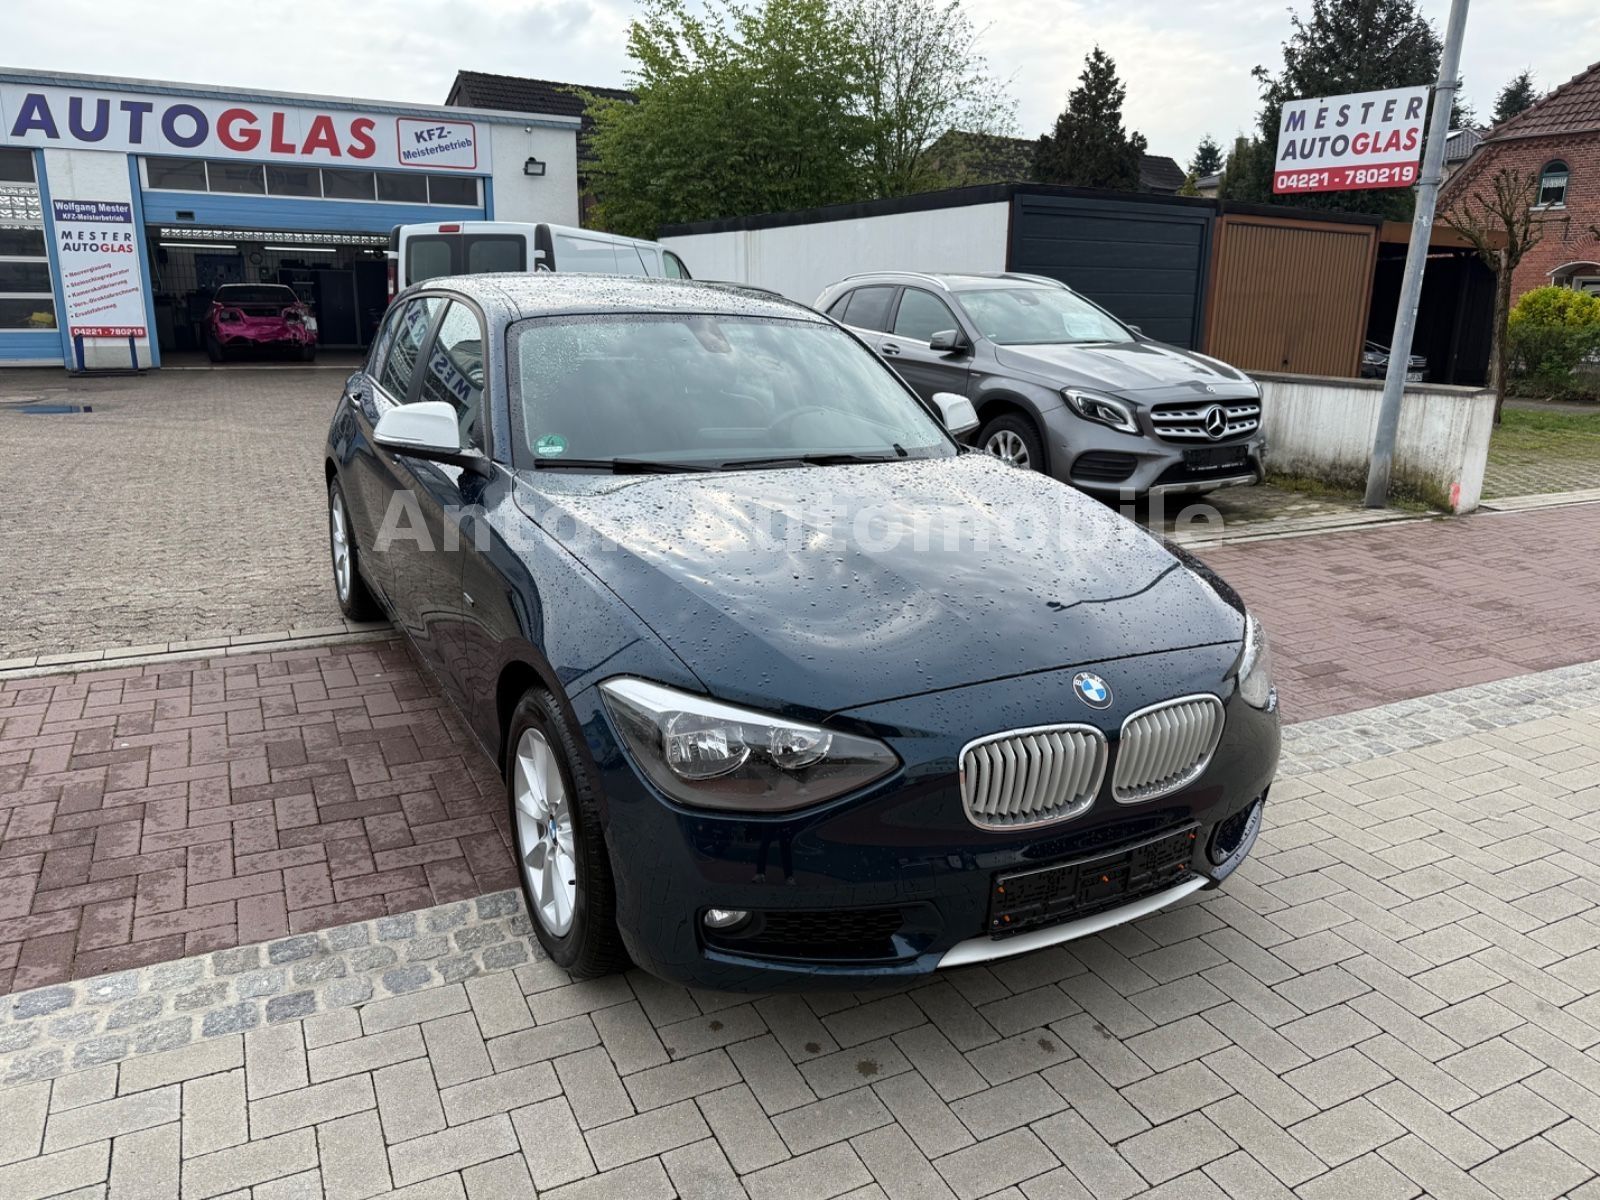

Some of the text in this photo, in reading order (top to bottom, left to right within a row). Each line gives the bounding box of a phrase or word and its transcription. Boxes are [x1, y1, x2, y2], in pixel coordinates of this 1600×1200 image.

[1284, 97, 1423, 132] MESTER
[10, 93, 376, 159] AUTOGLAS
[414, 126, 452, 144] KFZ-
[402, 138, 472, 160] Meisterbetrieb
[1280, 127, 1419, 161] AUTOGLAS
[1277, 172, 1329, 189] 04221
[1345, 166, 1414, 185] 780219
[55, 201, 129, 213] Wolfgang Mester
[62, 213, 124, 221] KFZ-Meisterbetrieb
[61, 230, 132, 242] MESTER
[62, 242, 133, 253] AUTOGLAS
